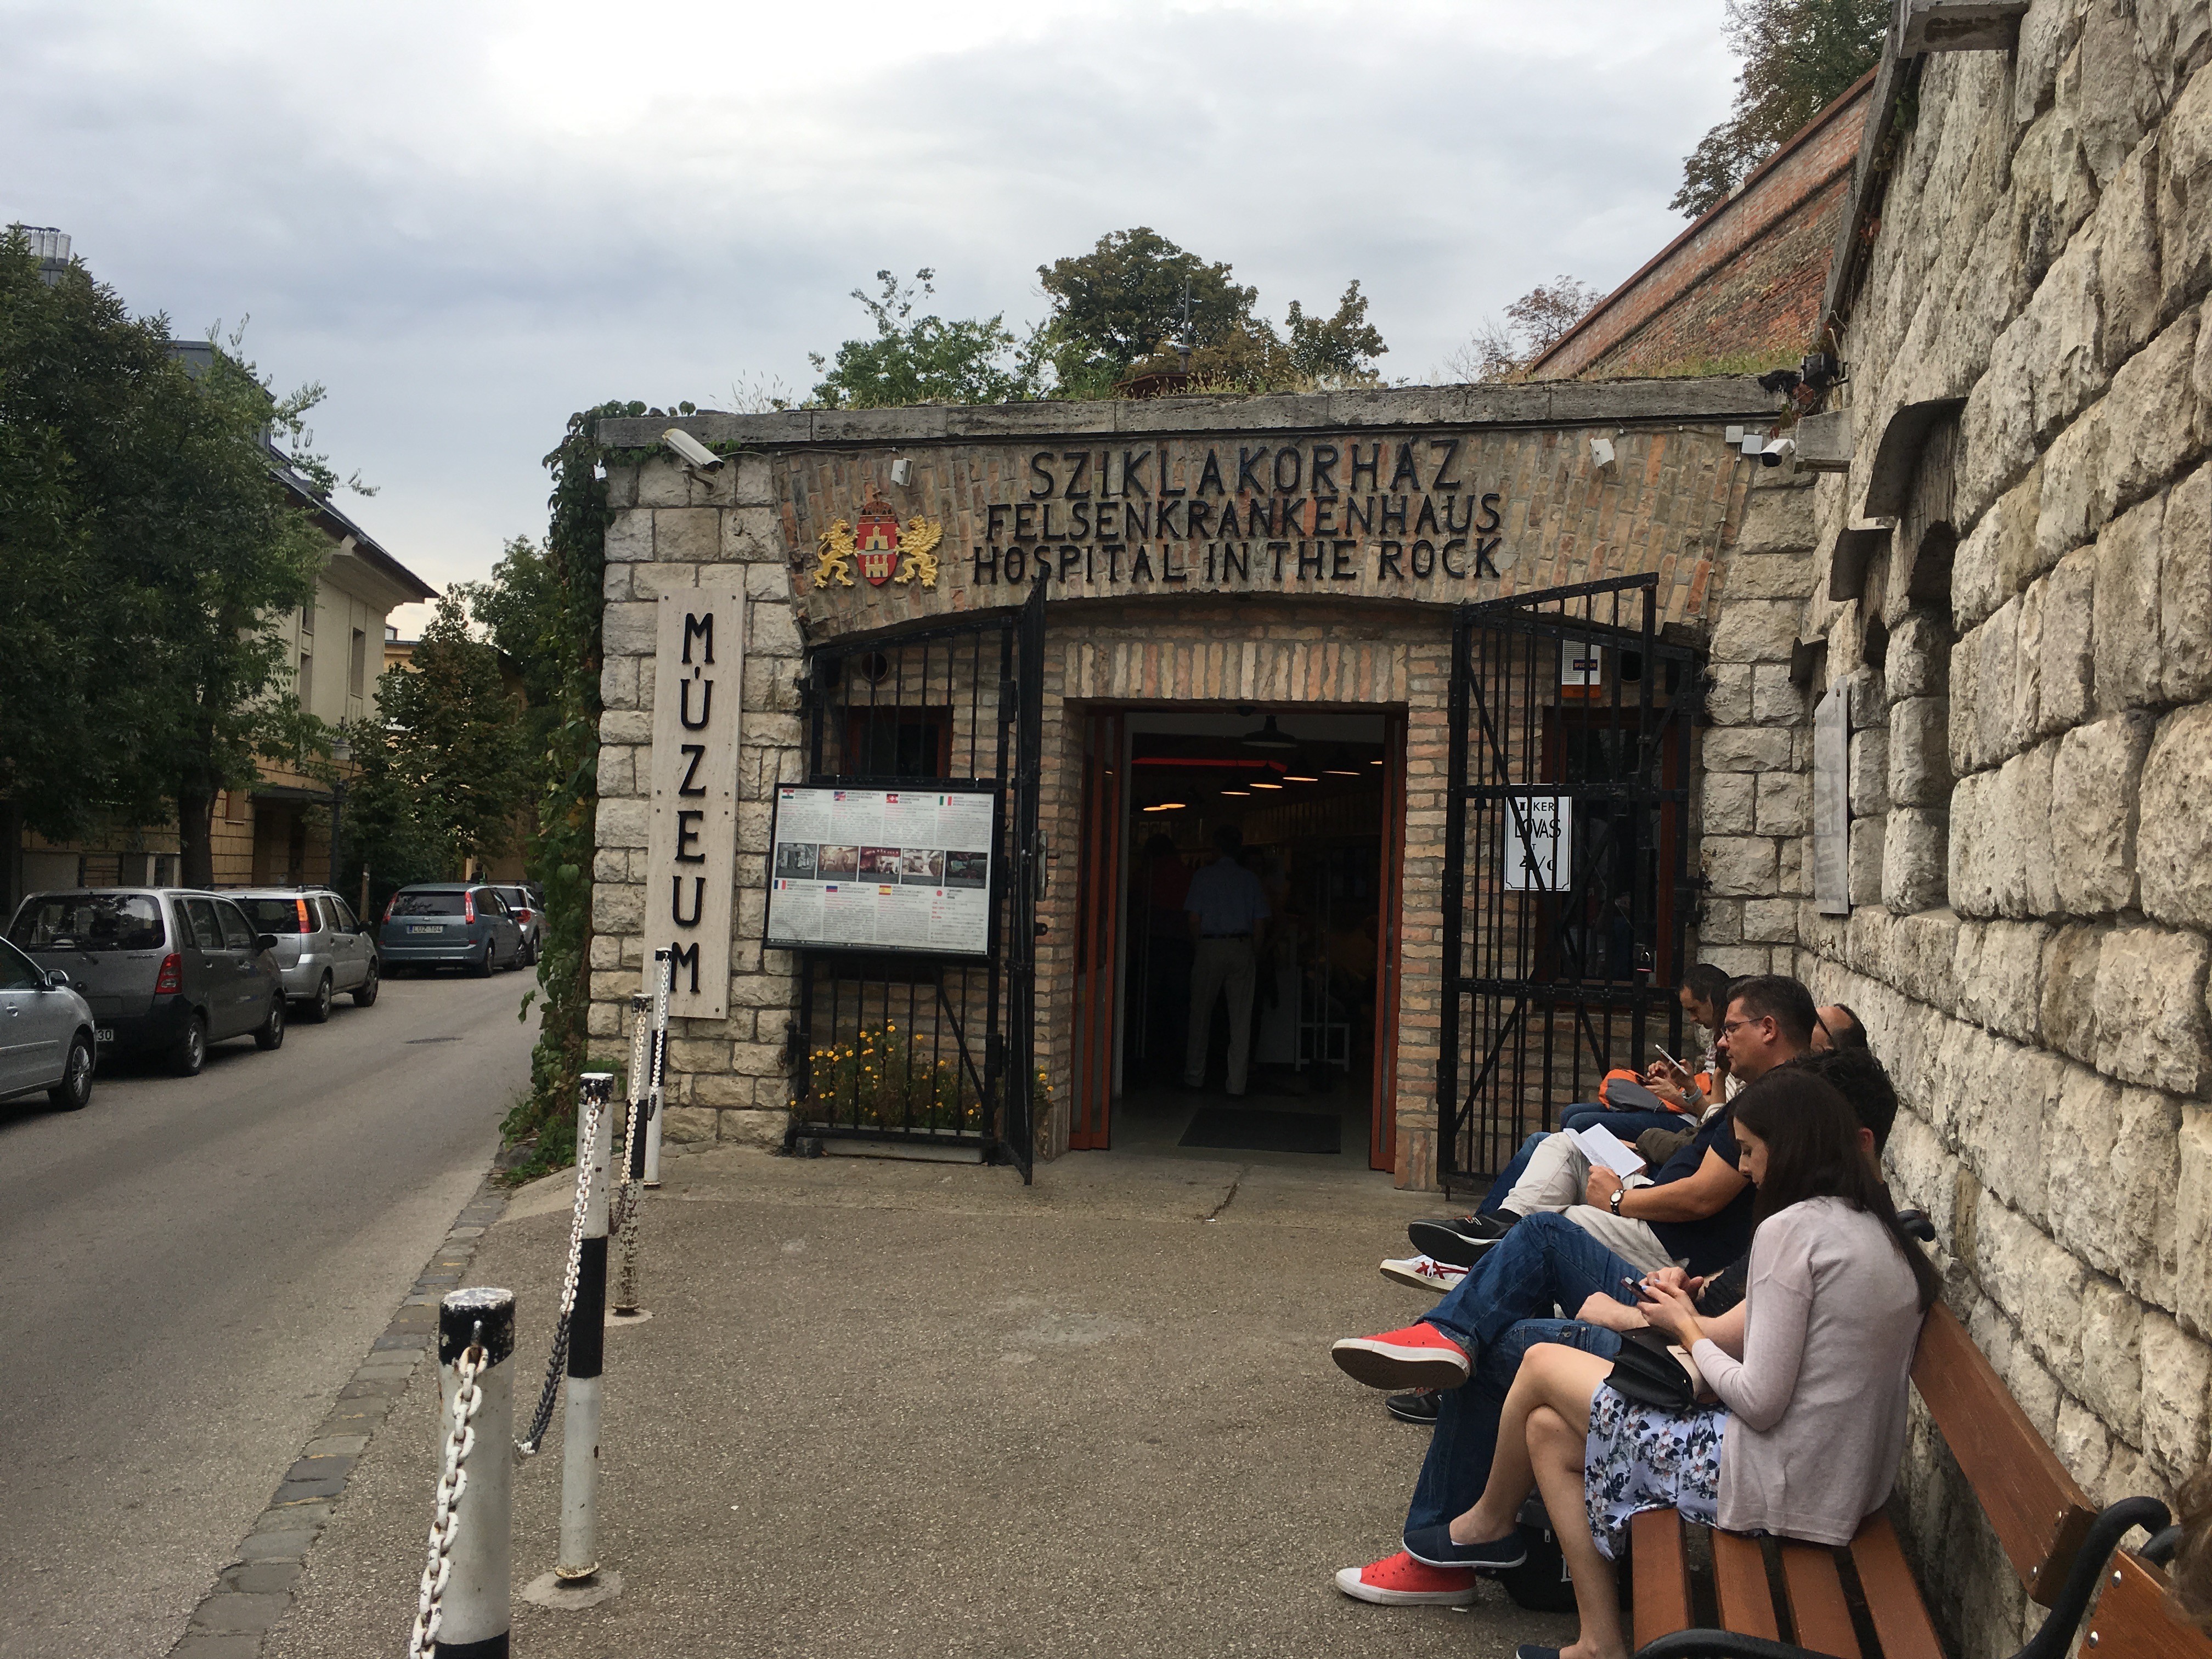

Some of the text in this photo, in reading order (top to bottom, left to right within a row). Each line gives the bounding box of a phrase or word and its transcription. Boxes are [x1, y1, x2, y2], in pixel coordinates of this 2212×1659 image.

[986, 493, 1500, 541] FELSENKRANKENHAUS
[973, 537, 1502, 585] HOSPITAL IN THE ROCK
